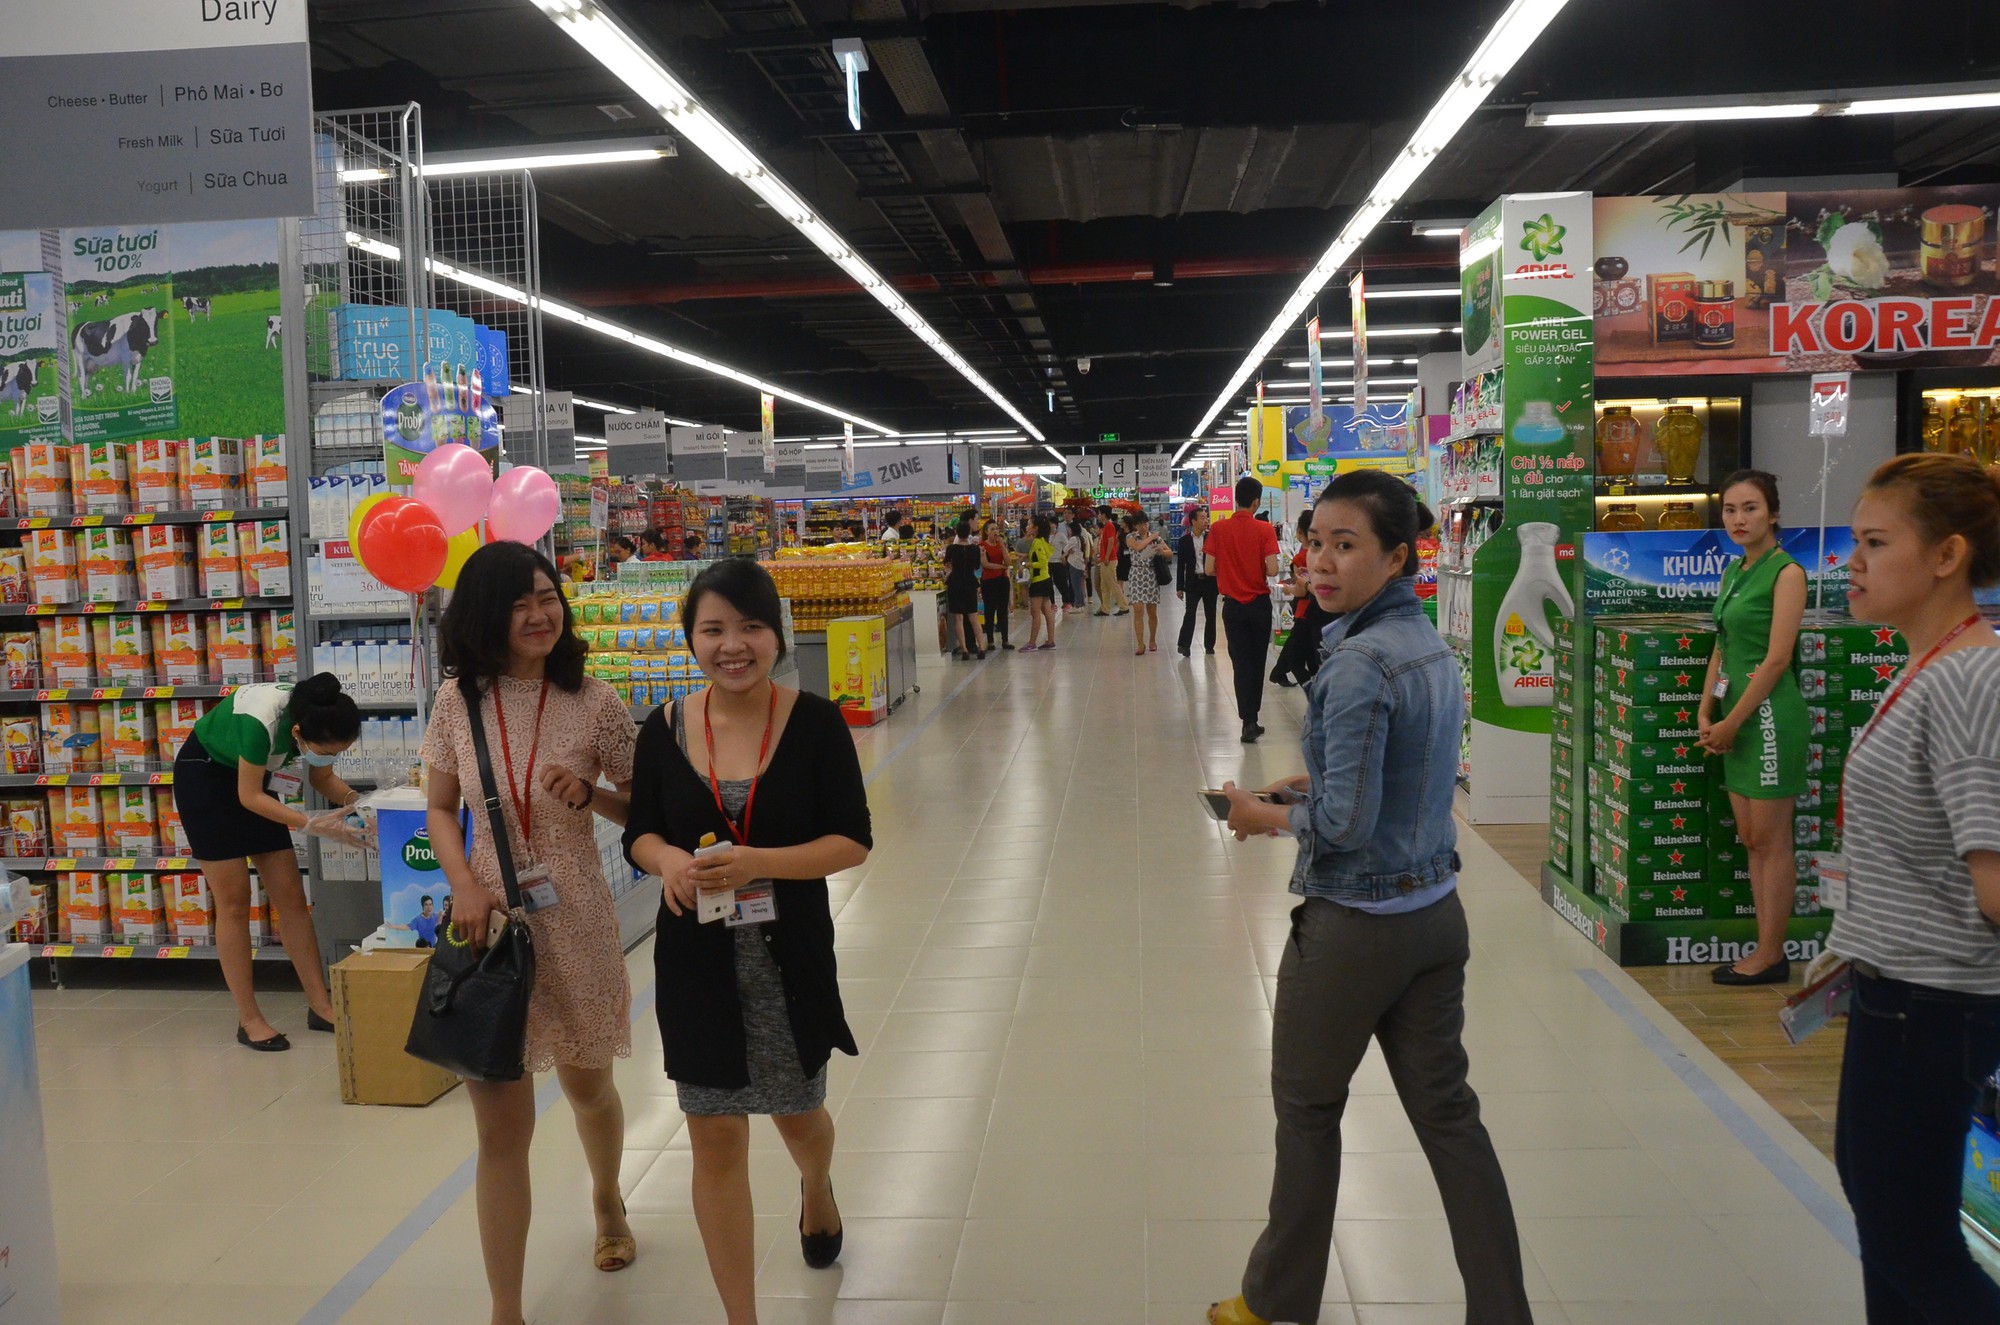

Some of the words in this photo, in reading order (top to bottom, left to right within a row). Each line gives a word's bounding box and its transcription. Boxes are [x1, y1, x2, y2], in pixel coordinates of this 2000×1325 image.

[48, 96, 97, 108] Cheese
[109, 93, 148, 105] Butter
[175, 86, 208, 102] Phô
[214, 84, 244, 99] Mai
[261, 82, 283, 97] Bơ
[118, 136, 154, 149] Fresh
[158, 134, 183, 147] Milk
[210, 128, 243, 145] Sữa
[249, 126, 286, 142] Tươi
[137, 180, 178, 195] Yogurt
[204, 173, 237, 189] Sữa
[243, 170, 288, 186] Chua
[73, 236, 114, 257] Sữa
[116, 229, 158, 252] tươi
[94, 253, 142, 273] 100%
[1531, 316, 1568, 327] ARIEL
[353, 319, 379, 336] TH
[1511, 329, 1558, 341] POWER
[1562, 328, 1587, 339] GEL
[353, 339, 400, 360] true
[1546, 356, 1552, 365] 2
[355, 359, 401, 378] MILK
[398, 411, 422, 431] Proby
[195, 441, 212, 452] AFC
[262, 439, 279, 450] AFC
[90, 447, 107, 458] AFC
[1511, 454, 1536, 470] Chỉ
[1557, 452, 1585, 471] nắp
[877, 456, 923, 484] ZONE
[1511, 475, 1520, 484] là
[1524, 469, 1543, 485] đủ
[1545, 474, 1564, 483] cho
[1511, 489, 1517, 498] 1
[1520, 488, 1534, 498] lần
[1537, 488, 1555, 500] giặt
[150, 531, 166, 542] AFC
[211, 528, 226, 539] AFC
[263, 526, 279, 537] AFC
[90, 533, 107, 544] AFC
[1663, 546, 1724, 576] KHUẤY
[1606, 579, 1626, 589] UEFA
[1657, 578, 1697, 601] CUỘC
[310, 592, 324, 600] tru
[1586, 588, 1647, 599] CHAMPIONS
[117, 619, 133, 629] AFC
[228, 616, 244, 626] AFC
[1660, 656, 1708, 666] Heineken
[360, 681, 380, 690] true
[382, 680, 402, 689] true
[361, 689, 380, 697] MILK
[1851, 689, 1883, 701] Hein
[121, 705, 136, 715] AFC
[342, 757, 361, 766] true
[1656, 764, 1704, 774] Heineken
[127, 790, 143, 801] AFC
[1654, 800, 1702, 810] Heineken
[1654, 835, 1701, 846] Heineken
[1653, 870, 1701, 881] Heineken
[76, 878, 91, 888] AFC
[129, 878, 144, 888] AFC
[182, 879, 199, 890] AFC
[1553, 885, 1594, 941] Heineken
[1655, 906, 1703, 917] Heineken
[1666, 935, 1819, 964] Heineen
